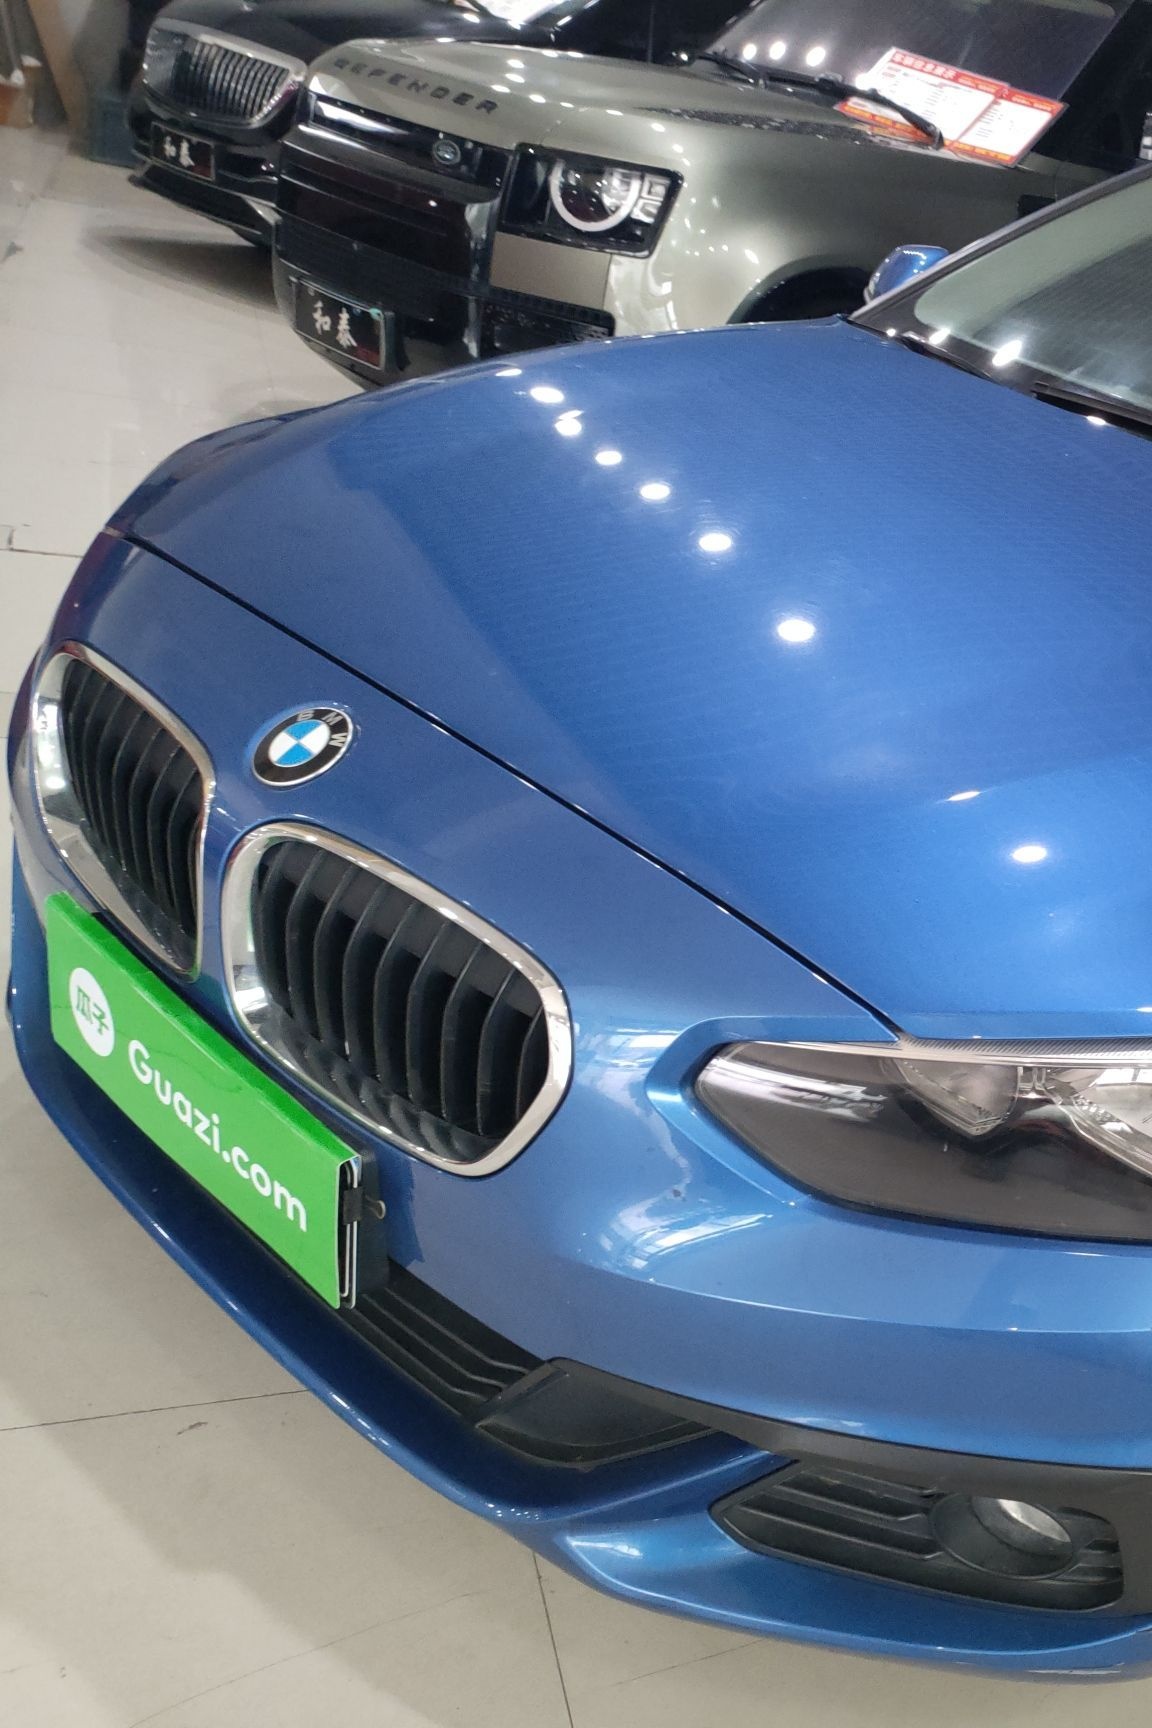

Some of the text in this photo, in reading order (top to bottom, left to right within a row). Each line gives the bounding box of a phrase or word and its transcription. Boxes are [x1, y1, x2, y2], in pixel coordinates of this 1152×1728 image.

[296, 709, 349, 748] BMW
[76, 985, 109, 1036] 瓜子
[128, 1039, 308, 1232] Guazi.com
